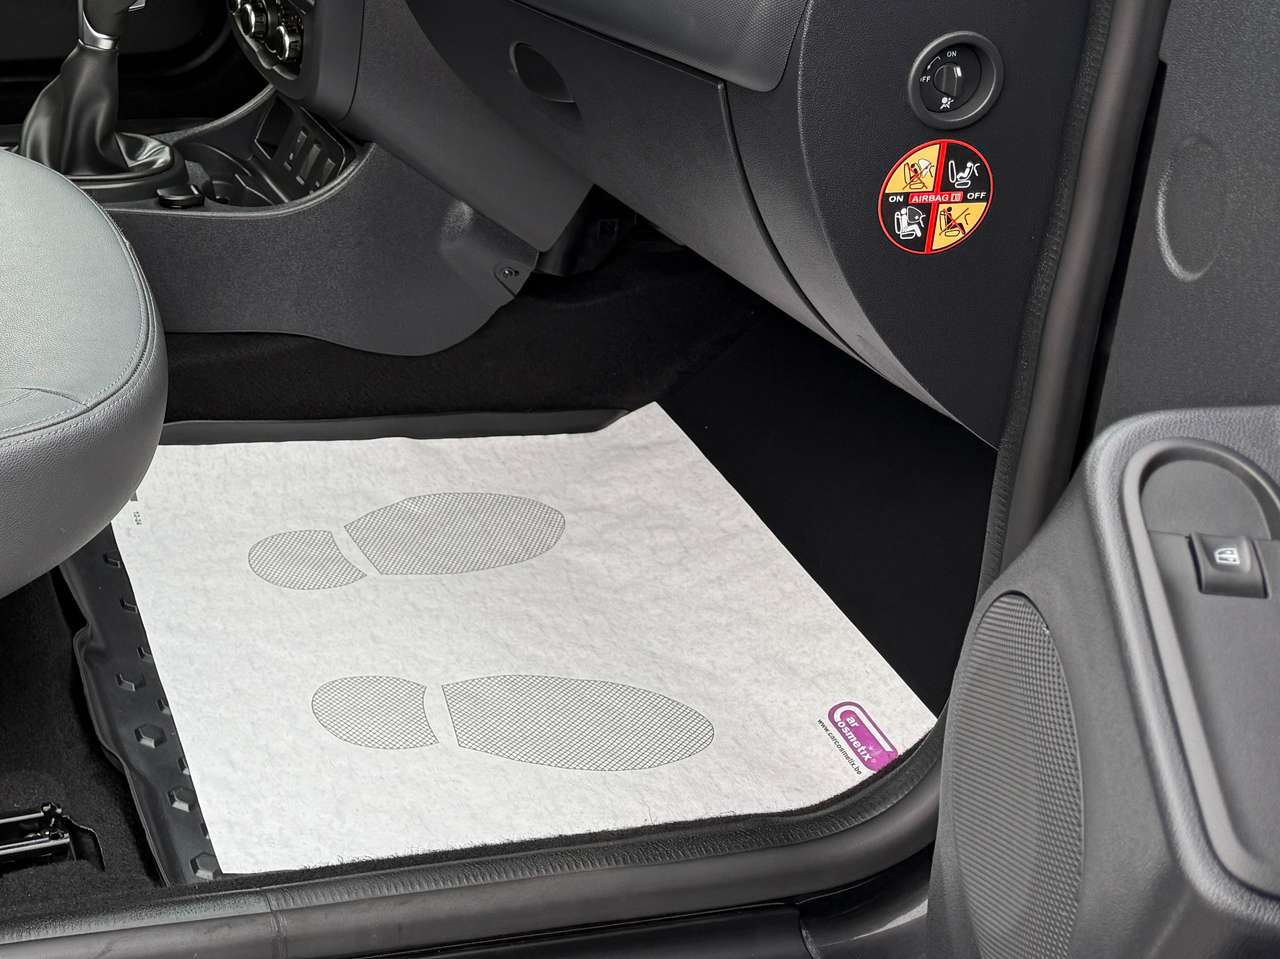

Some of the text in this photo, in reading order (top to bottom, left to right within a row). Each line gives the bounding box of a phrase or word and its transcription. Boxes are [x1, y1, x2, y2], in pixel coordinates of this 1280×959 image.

[946, 50, 957, 58] ON
[888, 191, 986, 203] ON AIRBAG OFF
[817, 719, 862, 775] www.carcosmetix.be
